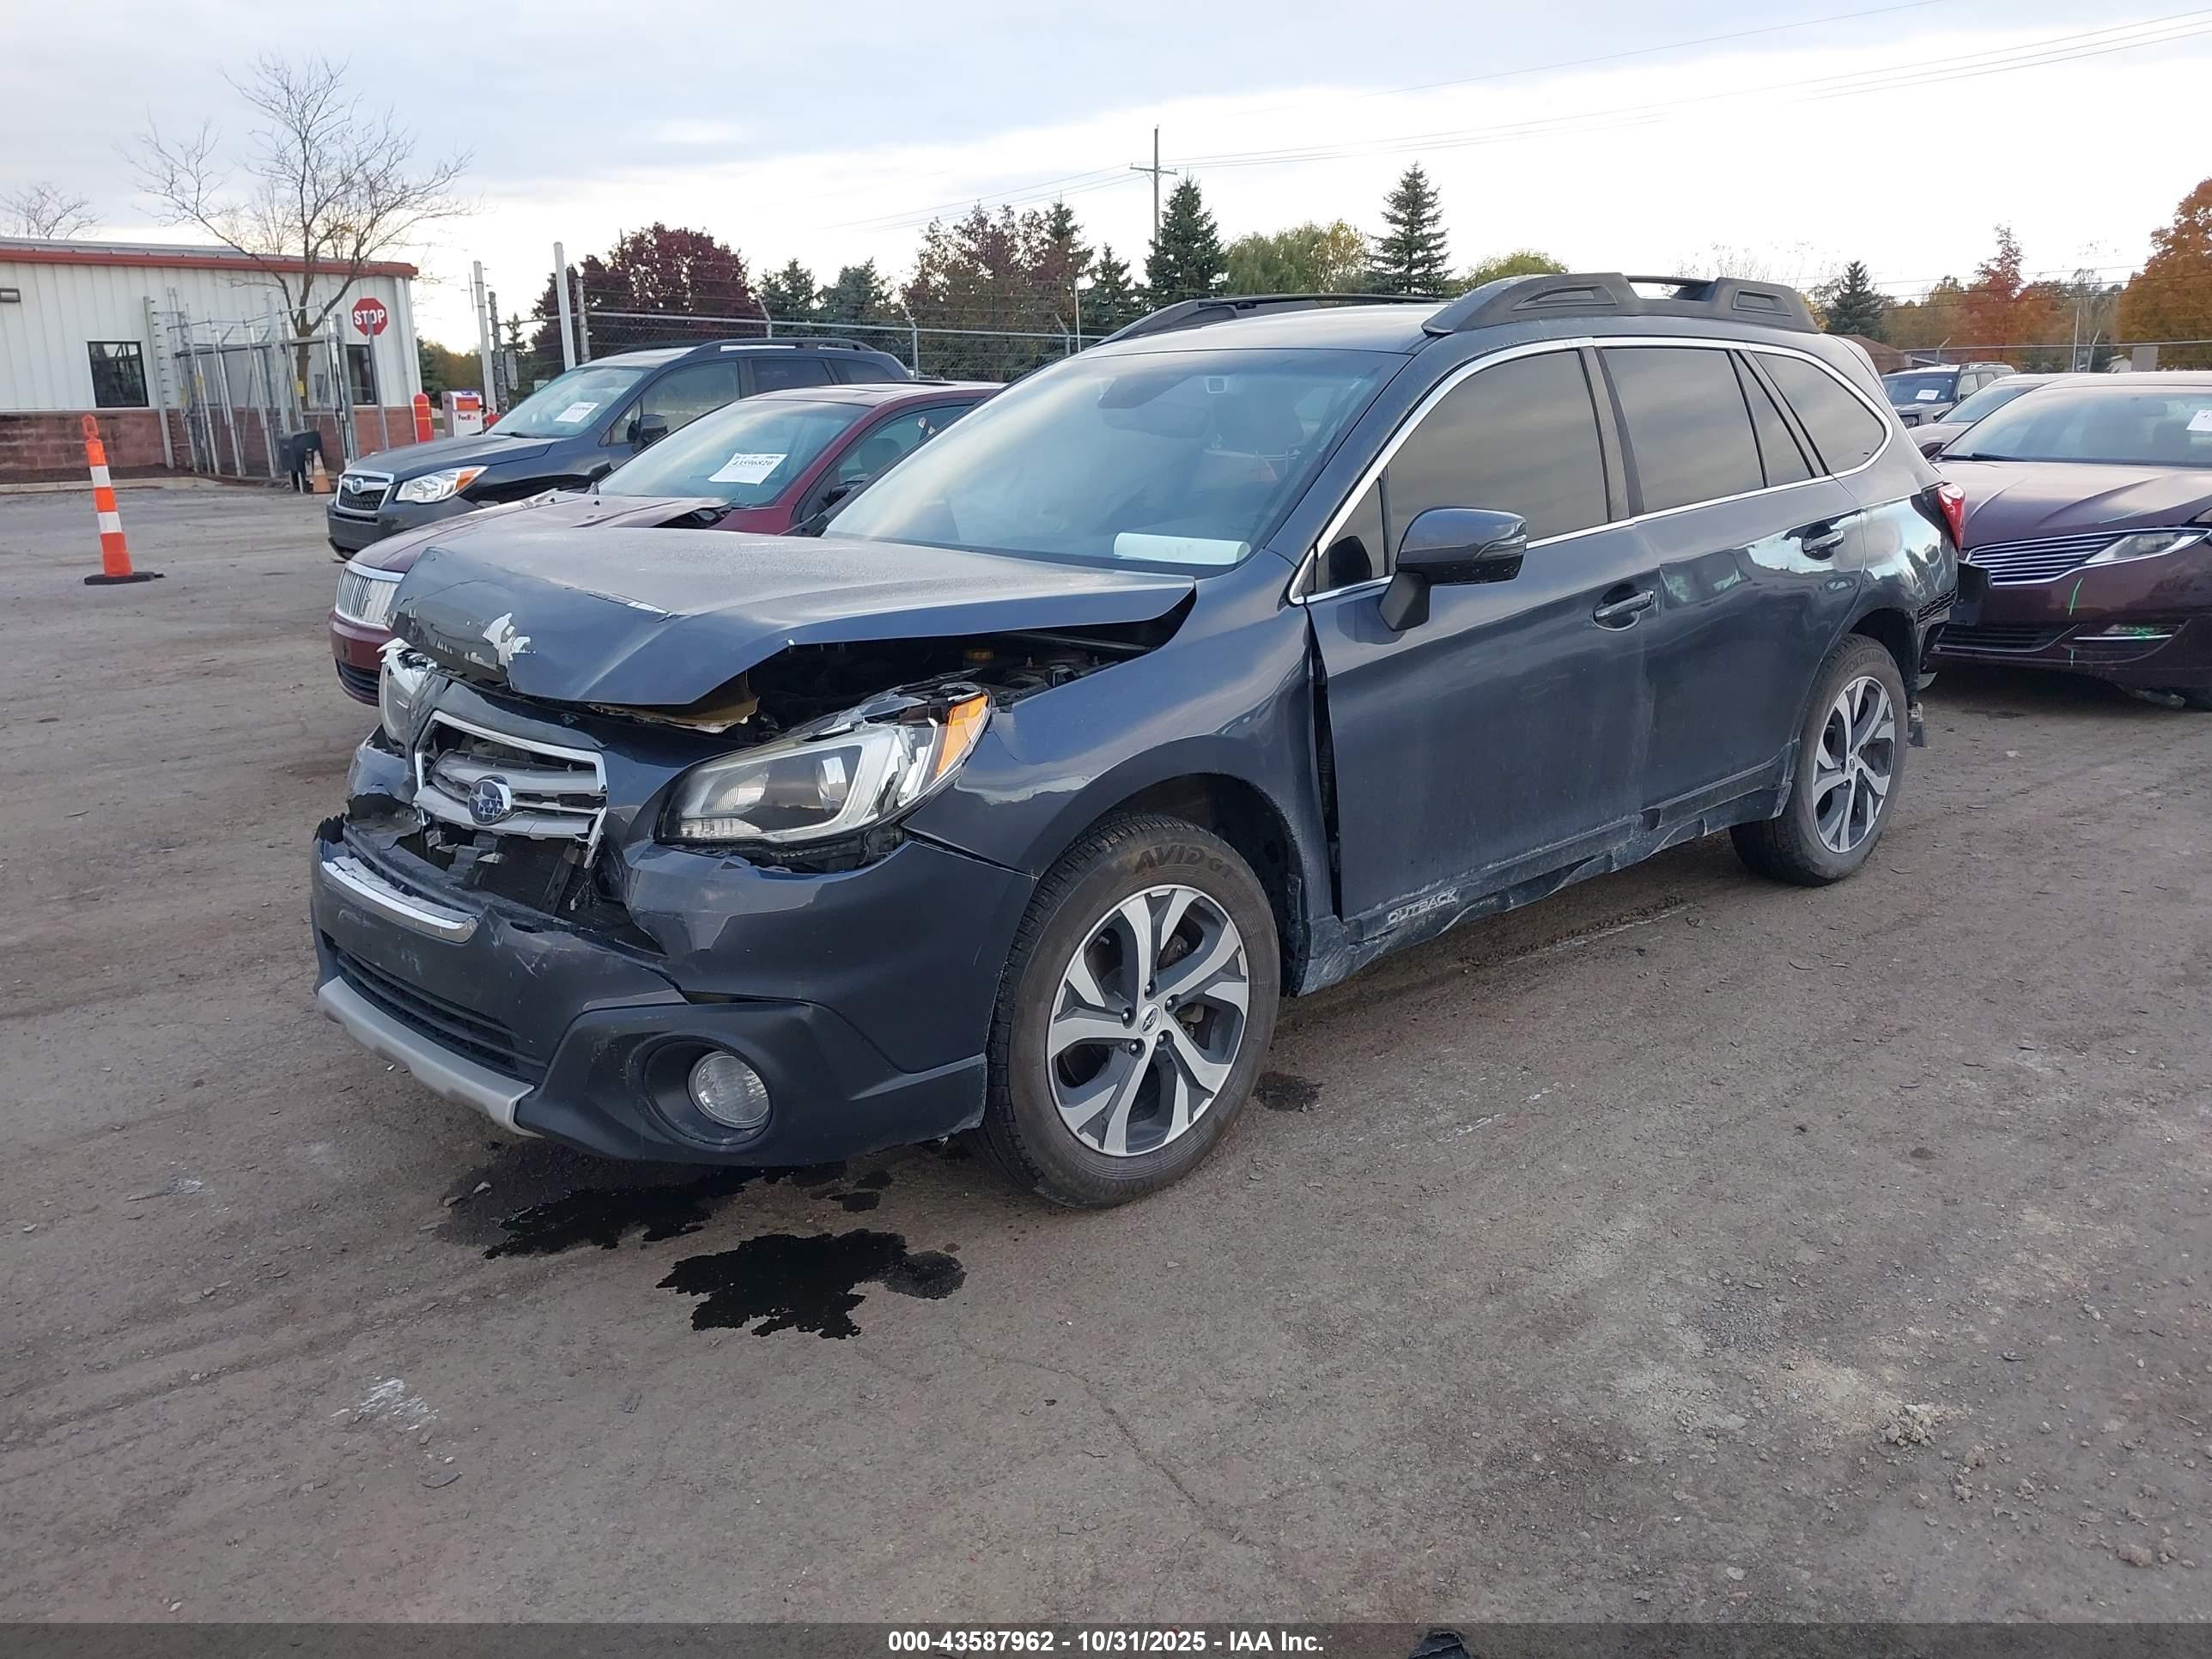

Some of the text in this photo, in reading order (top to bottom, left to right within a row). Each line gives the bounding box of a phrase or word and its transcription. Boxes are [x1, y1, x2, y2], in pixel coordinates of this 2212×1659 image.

[354, 309, 385, 325] STOP
[1134, 843, 1206, 875] AVID
[1387, 887, 1458, 924] OUTBACK
